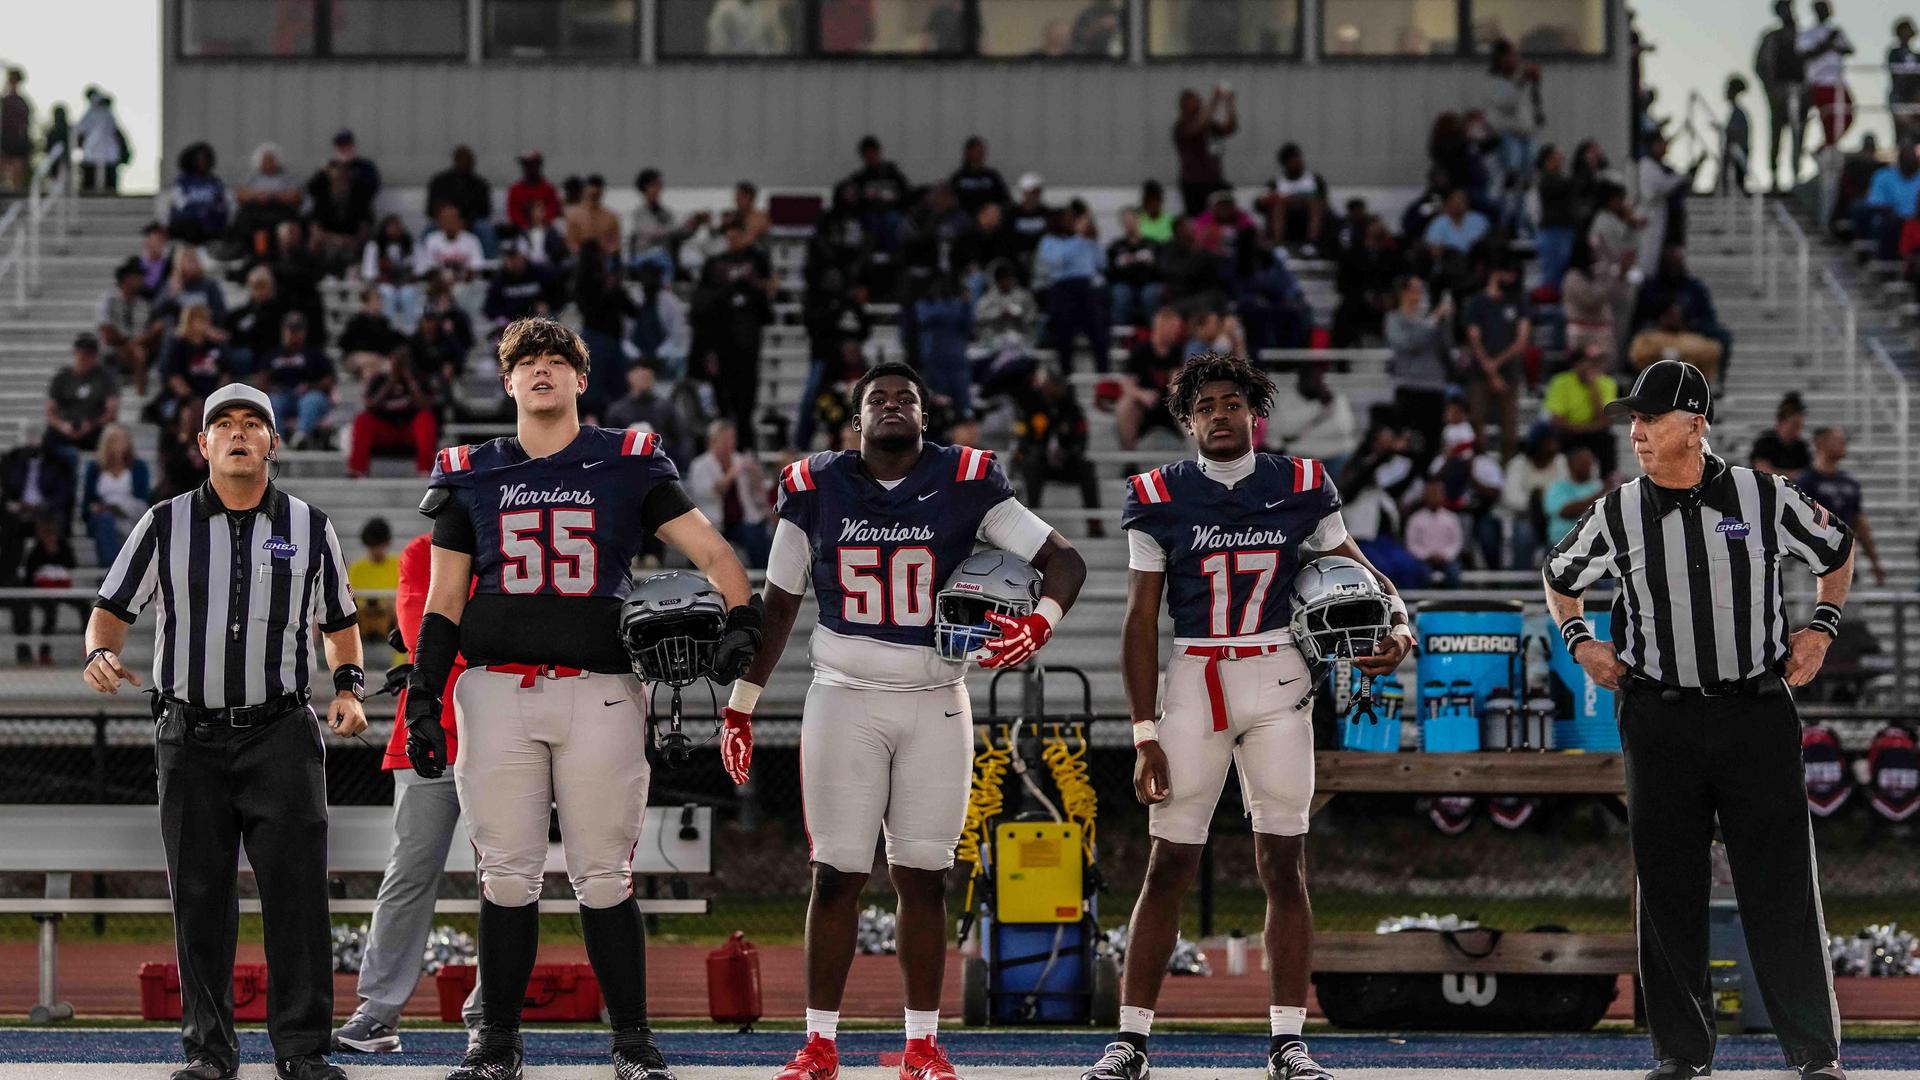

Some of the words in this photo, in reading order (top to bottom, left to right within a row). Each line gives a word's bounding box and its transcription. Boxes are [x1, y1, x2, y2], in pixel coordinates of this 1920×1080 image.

[499, 483, 595, 509] Warriors
[838, 518, 935, 542] Warriors
[1190, 525, 1287, 551] Warriors
[1716, 523, 1749, 531] GHSA
[263, 542, 297, 551] GHSA
[499, 507, 598, 596] 55
[837, 546, 936, 627] 50
[955, 582, 981, 591] Riddell
[1200, 549, 1280, 638] 17
[1428, 635, 1519, 652] POWERADE
